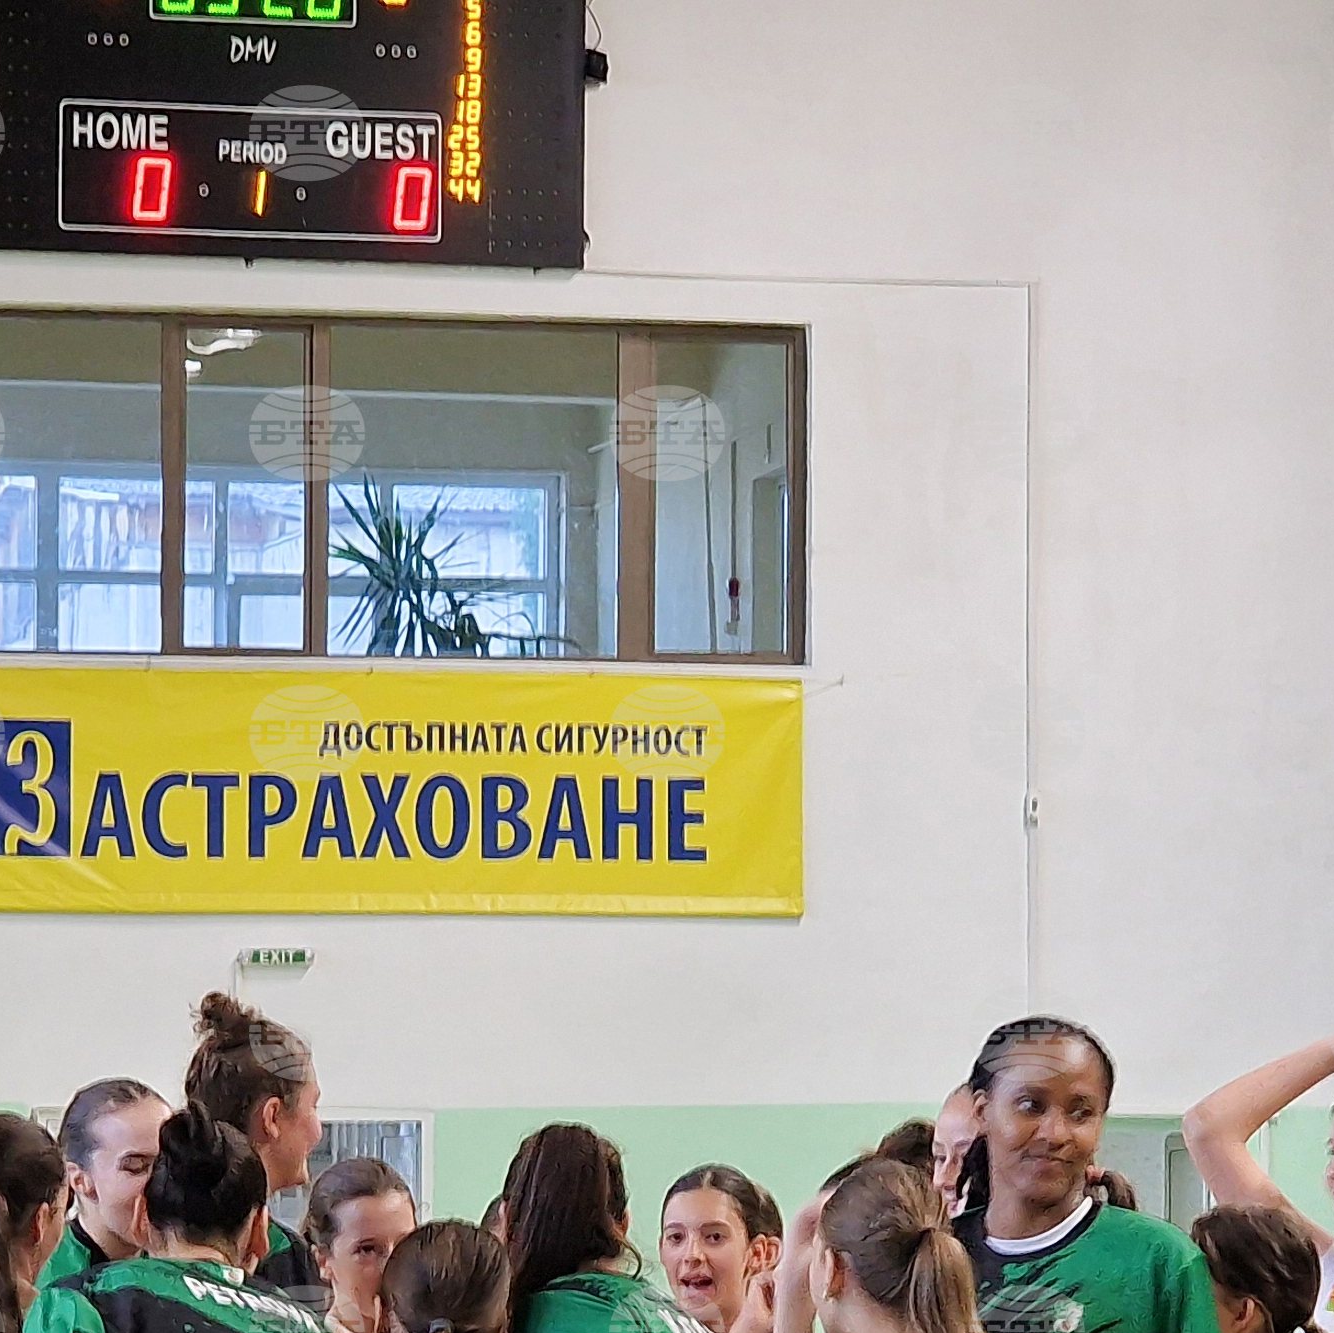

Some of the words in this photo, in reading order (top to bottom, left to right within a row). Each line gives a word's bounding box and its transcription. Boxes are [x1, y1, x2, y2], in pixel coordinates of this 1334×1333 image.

[229, 35, 278, 64] DMV
[72, 111, 169, 151] HOME
[325, 120, 437, 161] GUEST
[218, 138, 288, 165] PERIOD
[131, 156, 172, 222] 0
[251, 169, 268, 217] 1
[392, 165, 433, 231] 0
[318, 720, 528, 759] ДОСТЪПНАТА
[535, 721, 708, 758] СИГУРНОСТ
[1, 729, 708, 864] ЗАСТРАХОВАНЕ
[259, 948, 297, 966] EXIT
